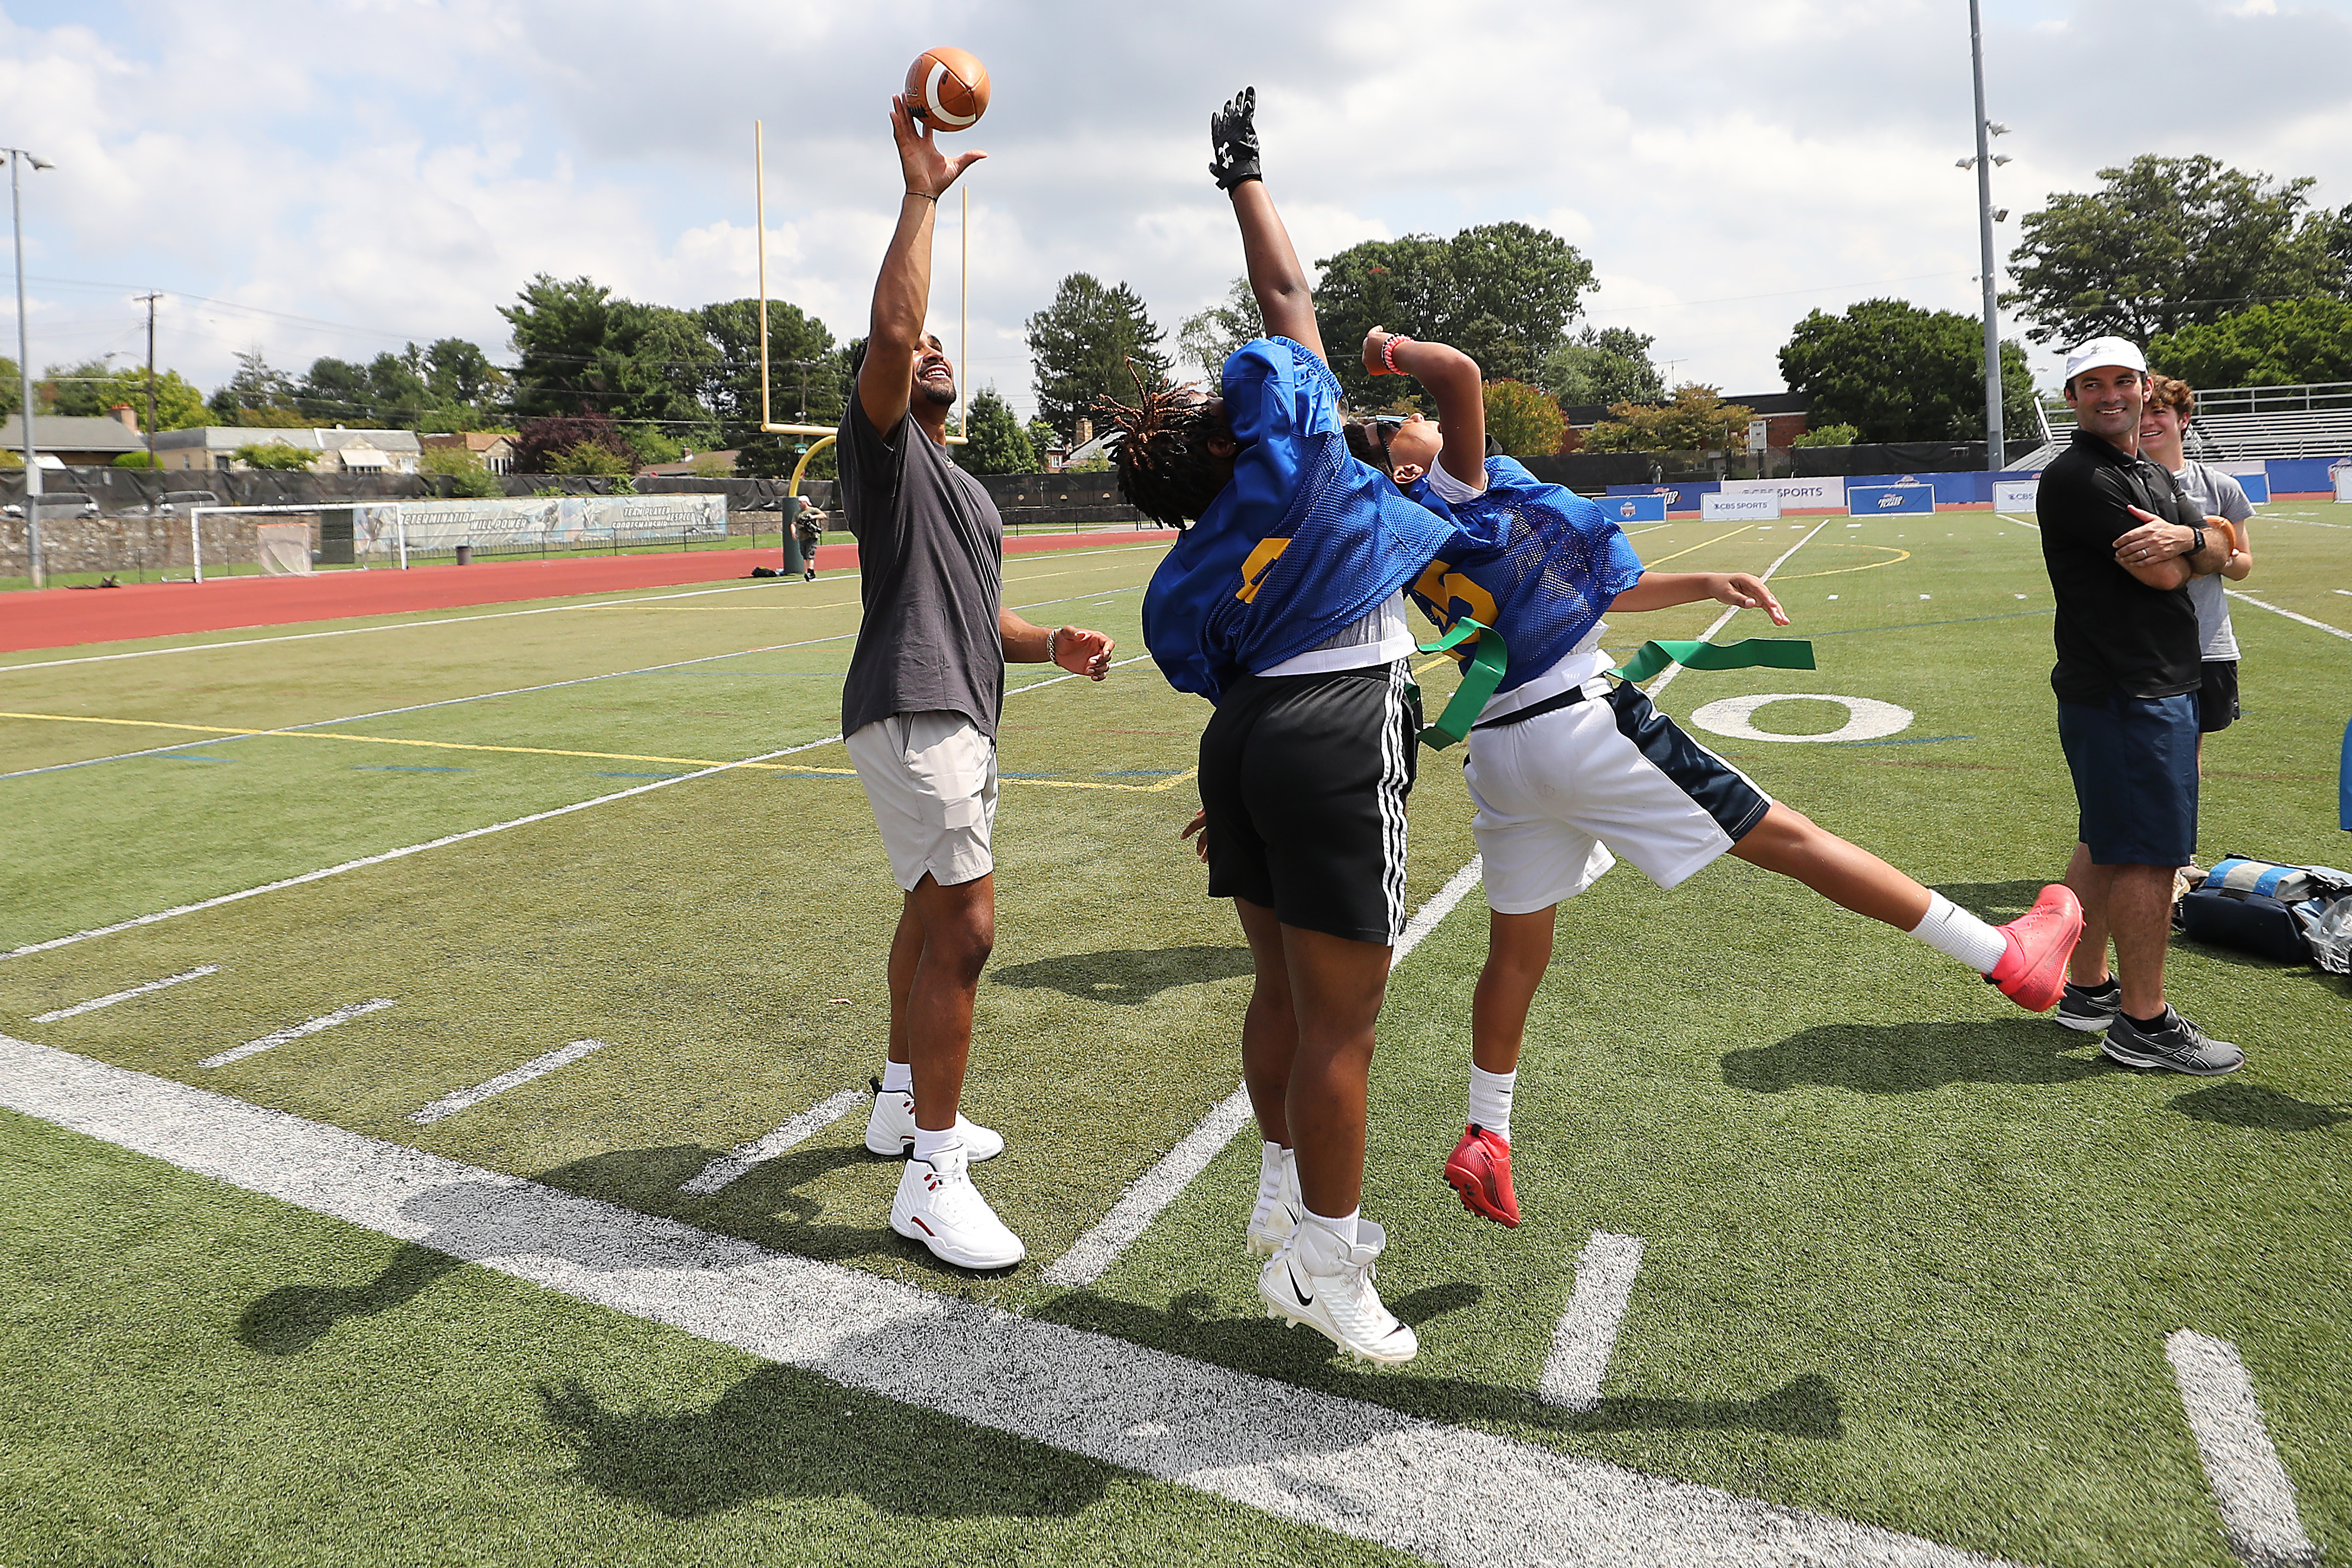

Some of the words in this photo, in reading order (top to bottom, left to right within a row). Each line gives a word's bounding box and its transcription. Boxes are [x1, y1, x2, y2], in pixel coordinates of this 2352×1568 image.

[1777, 487, 1822, 498] SPORTS
[624, 507, 643, 516] TEAM
[644, 506, 670, 516] PLAYER
[399, 511, 476, 525] DETERMINATION
[666, 513, 695, 521] RESPECT
[469, 520, 492, 530] WILL
[494, 518, 529, 529] POWER
